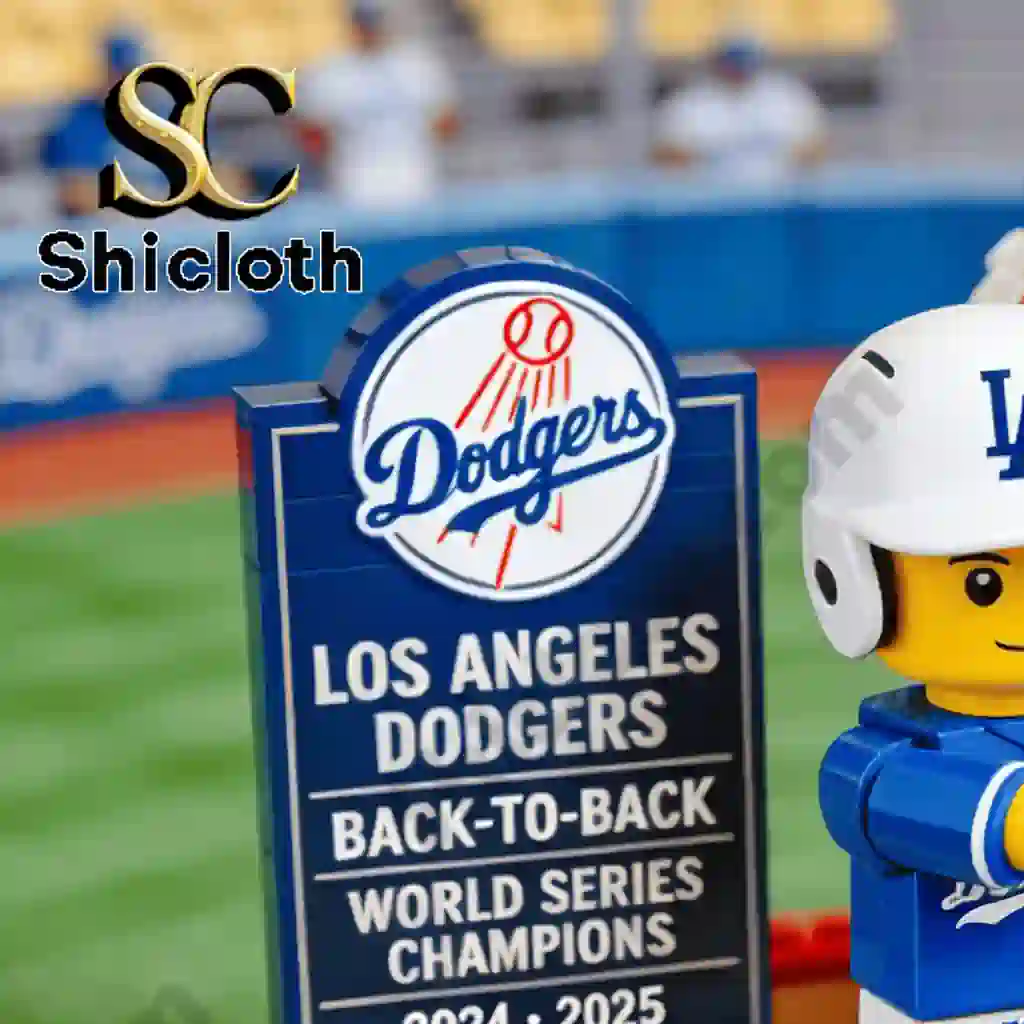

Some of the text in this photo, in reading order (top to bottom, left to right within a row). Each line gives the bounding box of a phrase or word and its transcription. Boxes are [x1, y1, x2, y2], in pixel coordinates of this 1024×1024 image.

[364, 388, 667, 533] Dodgers
[312, 612, 721, 705] LOS ANGELES
[375, 689, 668, 773] DODGERS
[331, 775, 717, 861] BACK-TO-BACK
[347, 855, 705, 934] WORLD SERIES
[387, 912, 677, 984] CHAMPIONS
